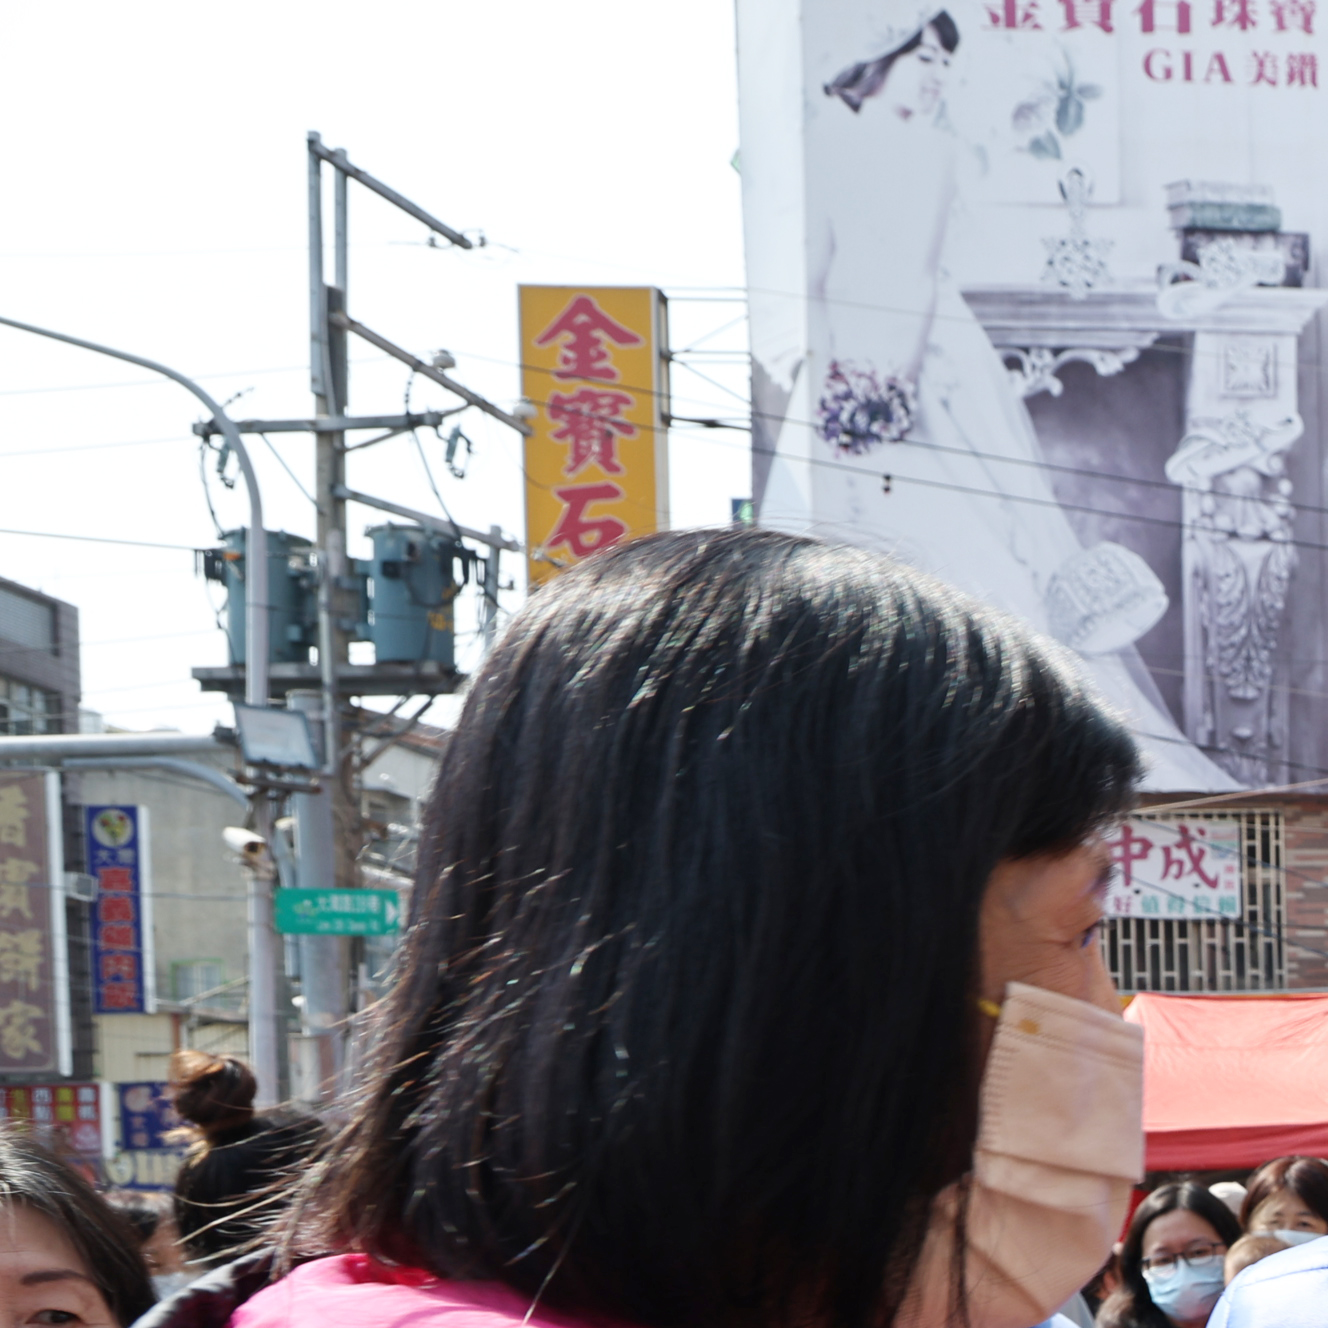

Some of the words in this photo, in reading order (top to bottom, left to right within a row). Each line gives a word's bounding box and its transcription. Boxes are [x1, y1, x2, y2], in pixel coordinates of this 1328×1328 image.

[1142, 48, 1234, 84] GIA
[532, 294, 645, 558] 金寶石
